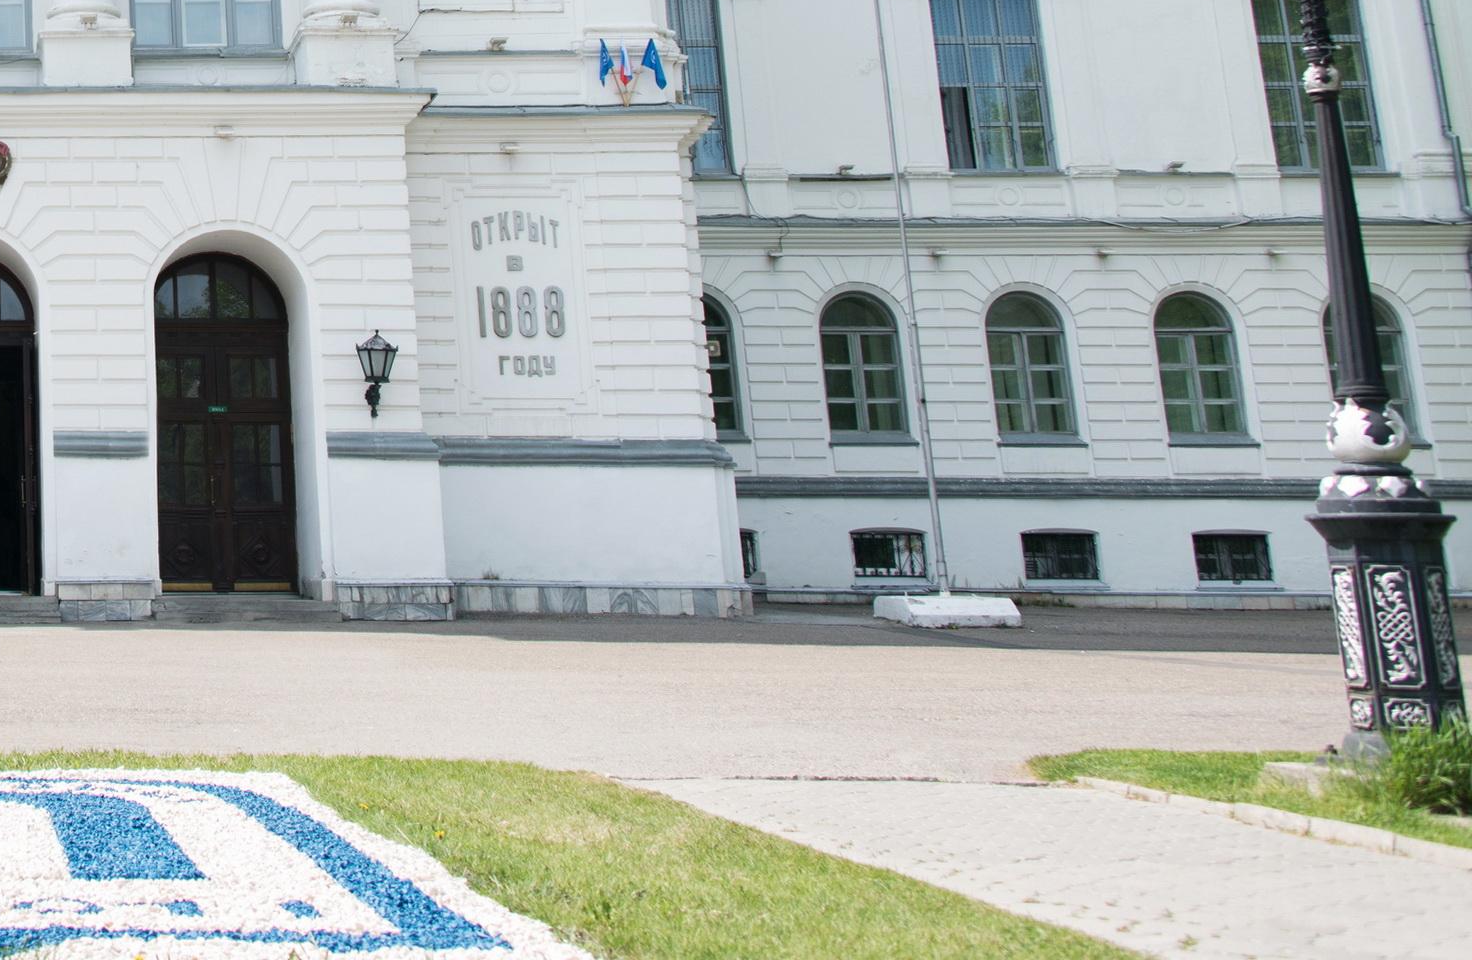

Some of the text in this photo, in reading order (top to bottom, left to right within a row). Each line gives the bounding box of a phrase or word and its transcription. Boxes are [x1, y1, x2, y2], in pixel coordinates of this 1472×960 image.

[470, 209, 560, 252] ОТКРЫТ
[505, 254, 524, 273] В
[475, 285, 566, 339] 1888
[497, 354, 557, 378] ГОДУ
